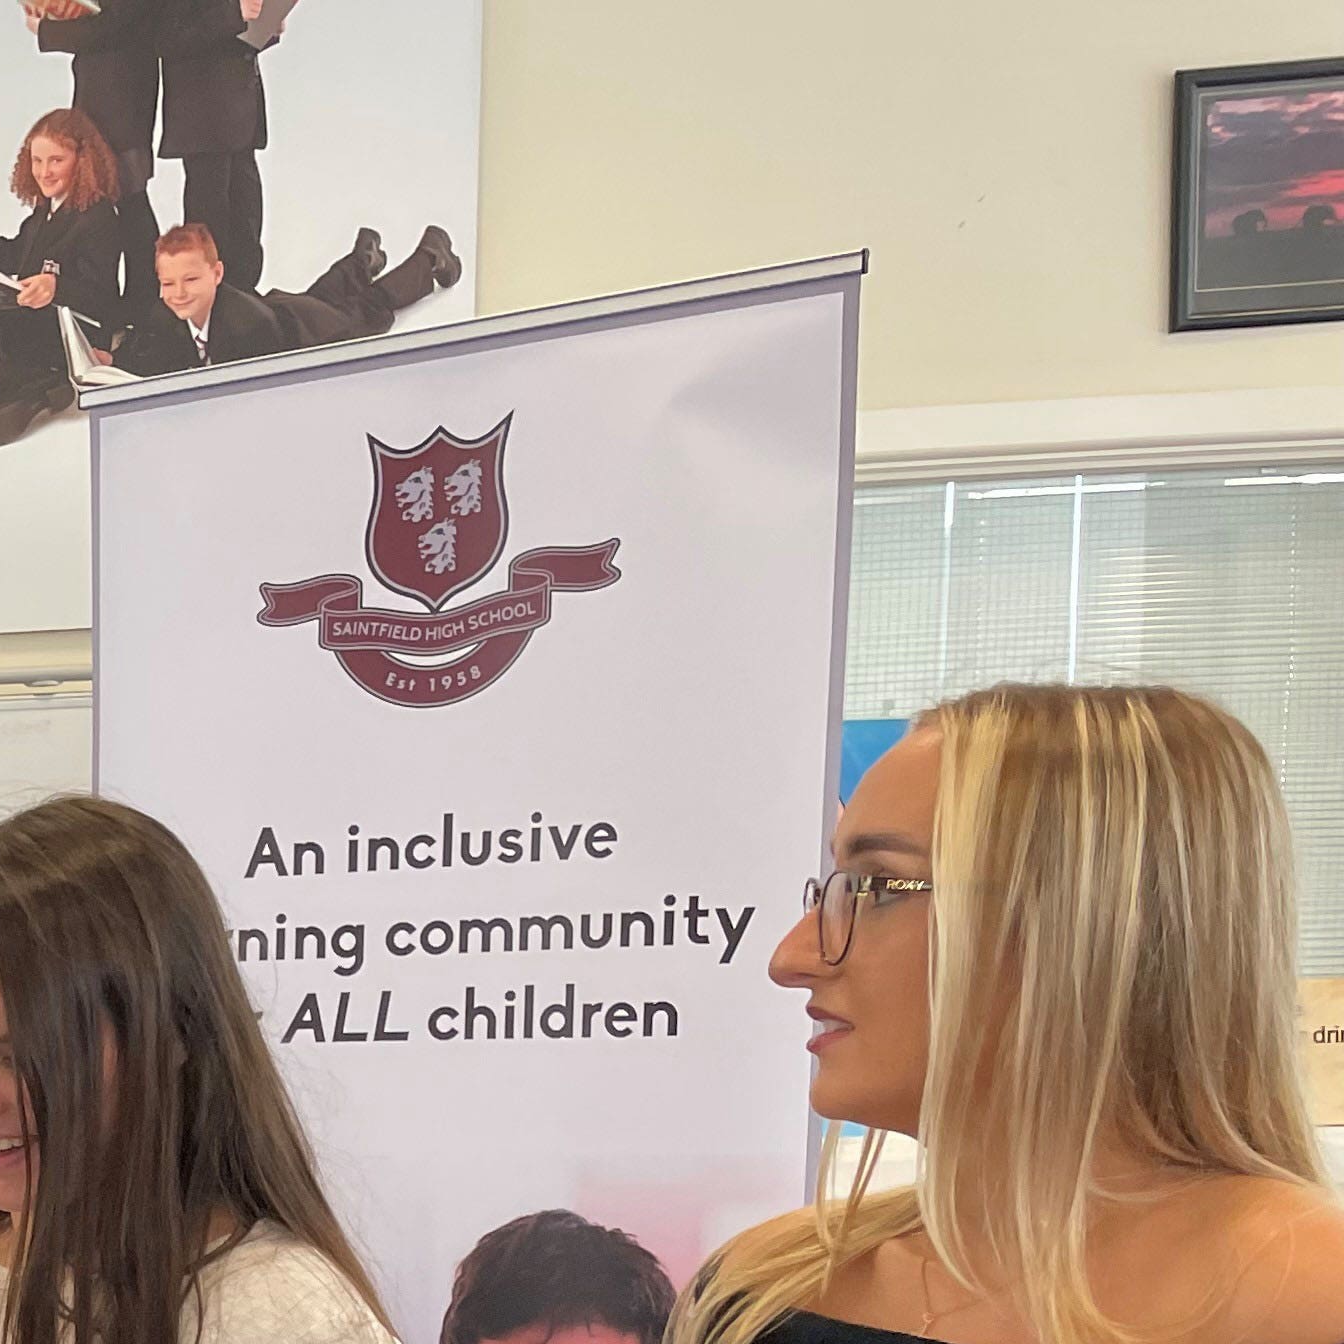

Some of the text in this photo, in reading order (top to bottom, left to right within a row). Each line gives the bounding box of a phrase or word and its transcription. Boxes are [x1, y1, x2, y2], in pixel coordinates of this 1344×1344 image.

[332, 602, 536, 641] SAINTFIELD HIGH SCHOOL
[385, 665, 482, 692] Est 1958
[244, 811, 618, 879] An inclusive
[231, 894, 756, 976] ning community
[280, 984, 679, 1044] ALL children
